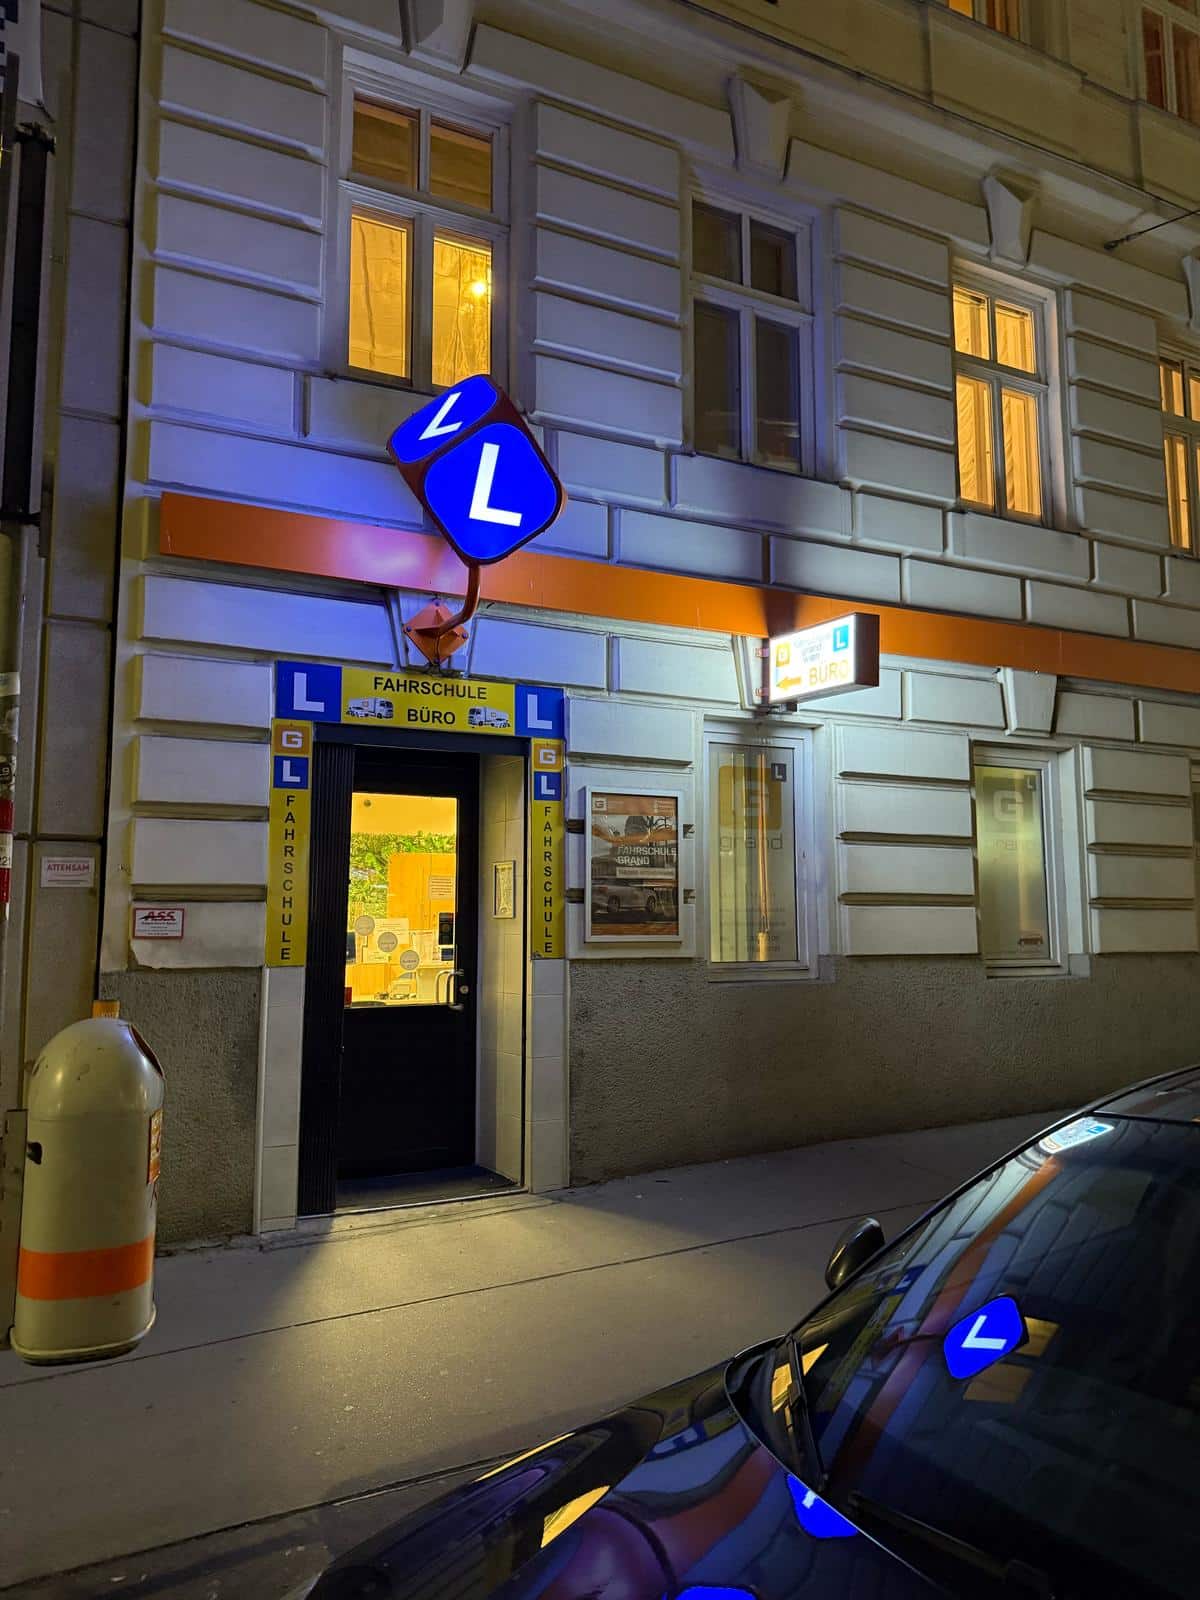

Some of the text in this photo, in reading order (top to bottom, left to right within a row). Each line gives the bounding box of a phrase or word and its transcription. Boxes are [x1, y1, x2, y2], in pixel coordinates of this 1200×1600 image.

[419, 391, 464, 441] L
[469, 442, 522, 527] L
[836, 630, 846, 648] L
[293, 672, 325, 712] L
[373, 676, 487, 700] FAHRSCHULE
[407, 706, 456, 725] BÜRO
[527, 694, 553, 730] L
[281, 731, 303, 748] G
[539, 749, 556, 764] G
[282, 760, 301, 783] L
[541, 776, 556, 795] L
[616, 856, 650, 865] GRAND
[617, 846, 677, 856] FAHRSCHULE
[280, 795, 296, 961] FAHRSCHULE
[543, 806, 553, 953] FAHRSCHULE
